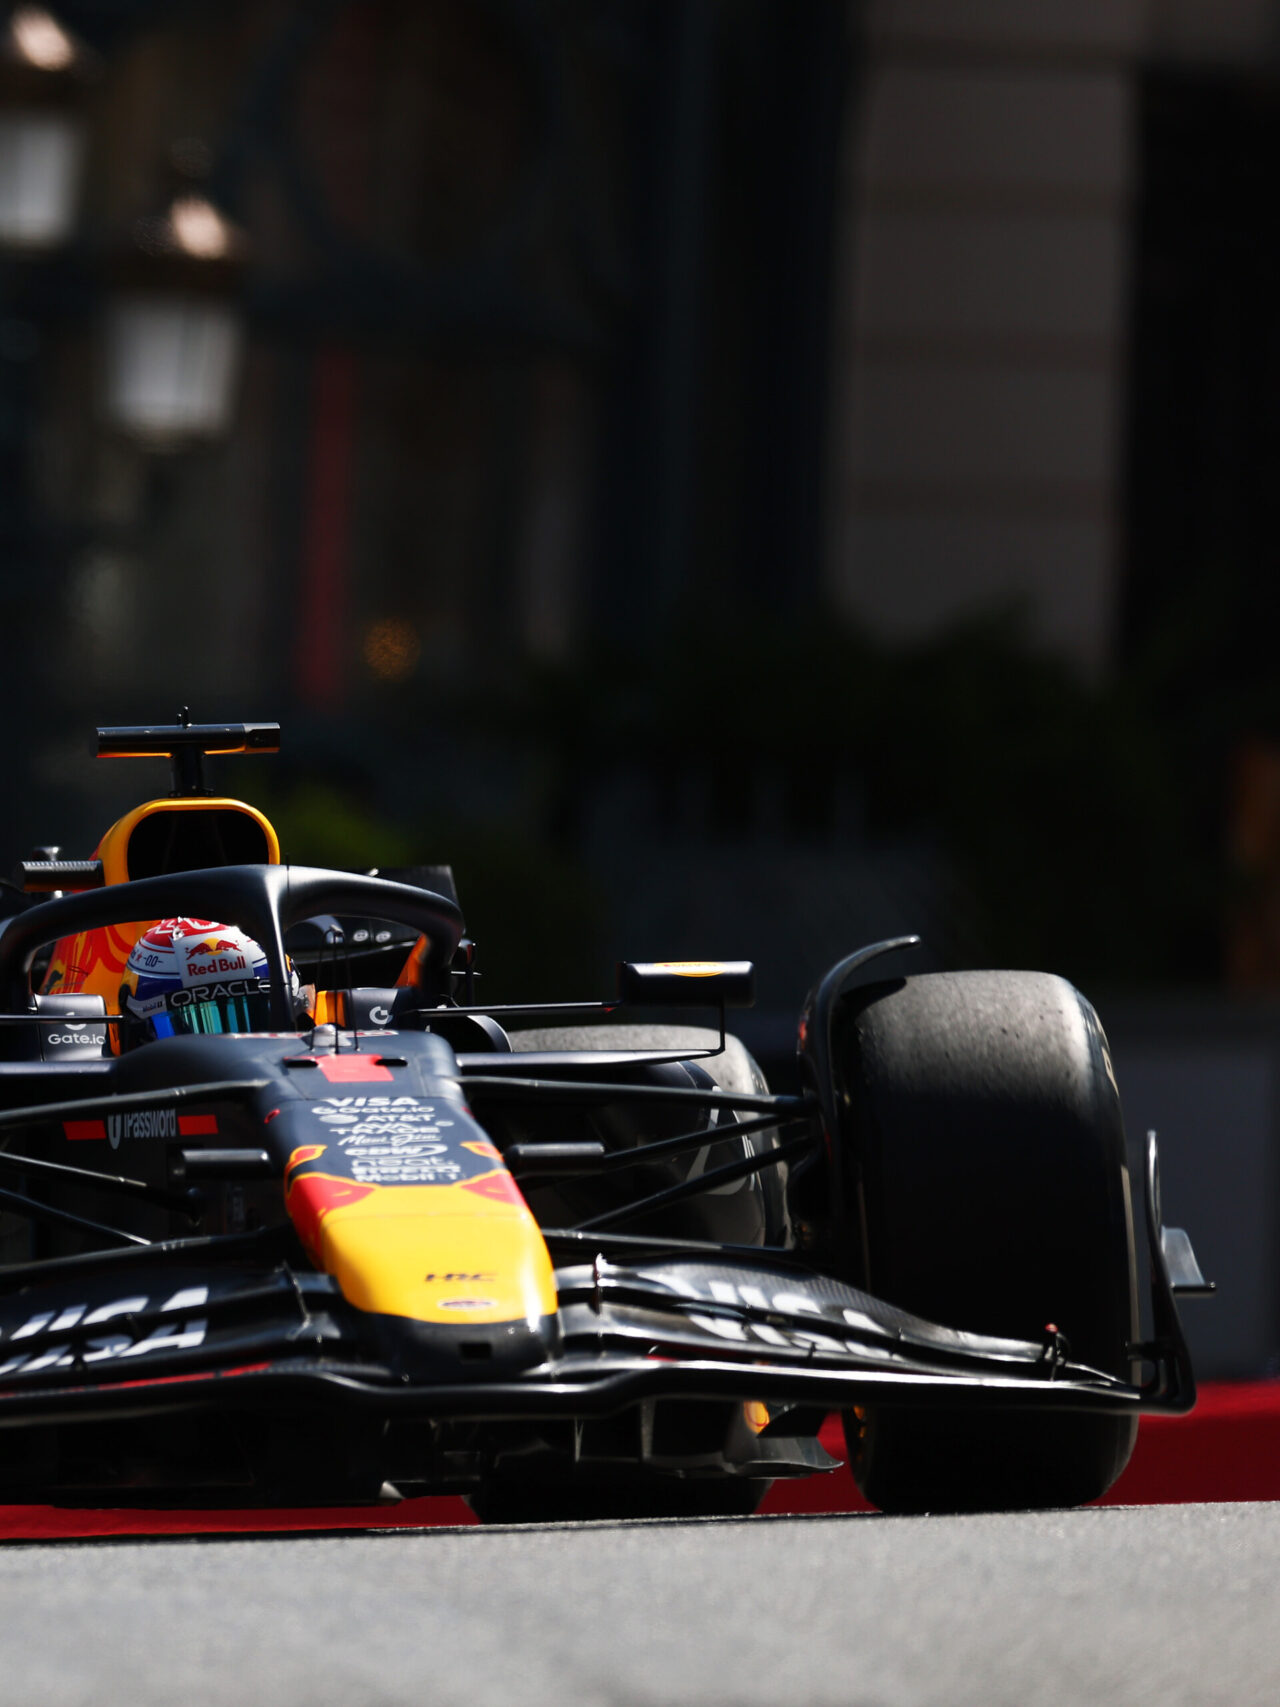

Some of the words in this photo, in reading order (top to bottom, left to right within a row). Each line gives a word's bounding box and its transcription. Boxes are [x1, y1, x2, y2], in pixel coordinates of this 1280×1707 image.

[187, 959, 218, 977] Red
[219, 955, 246, 973] Bull
[170, 979, 270, 1007] ORACLE
[322, 1097, 420, 1107] VISA
[365, 1114, 436, 1122] AT&T
